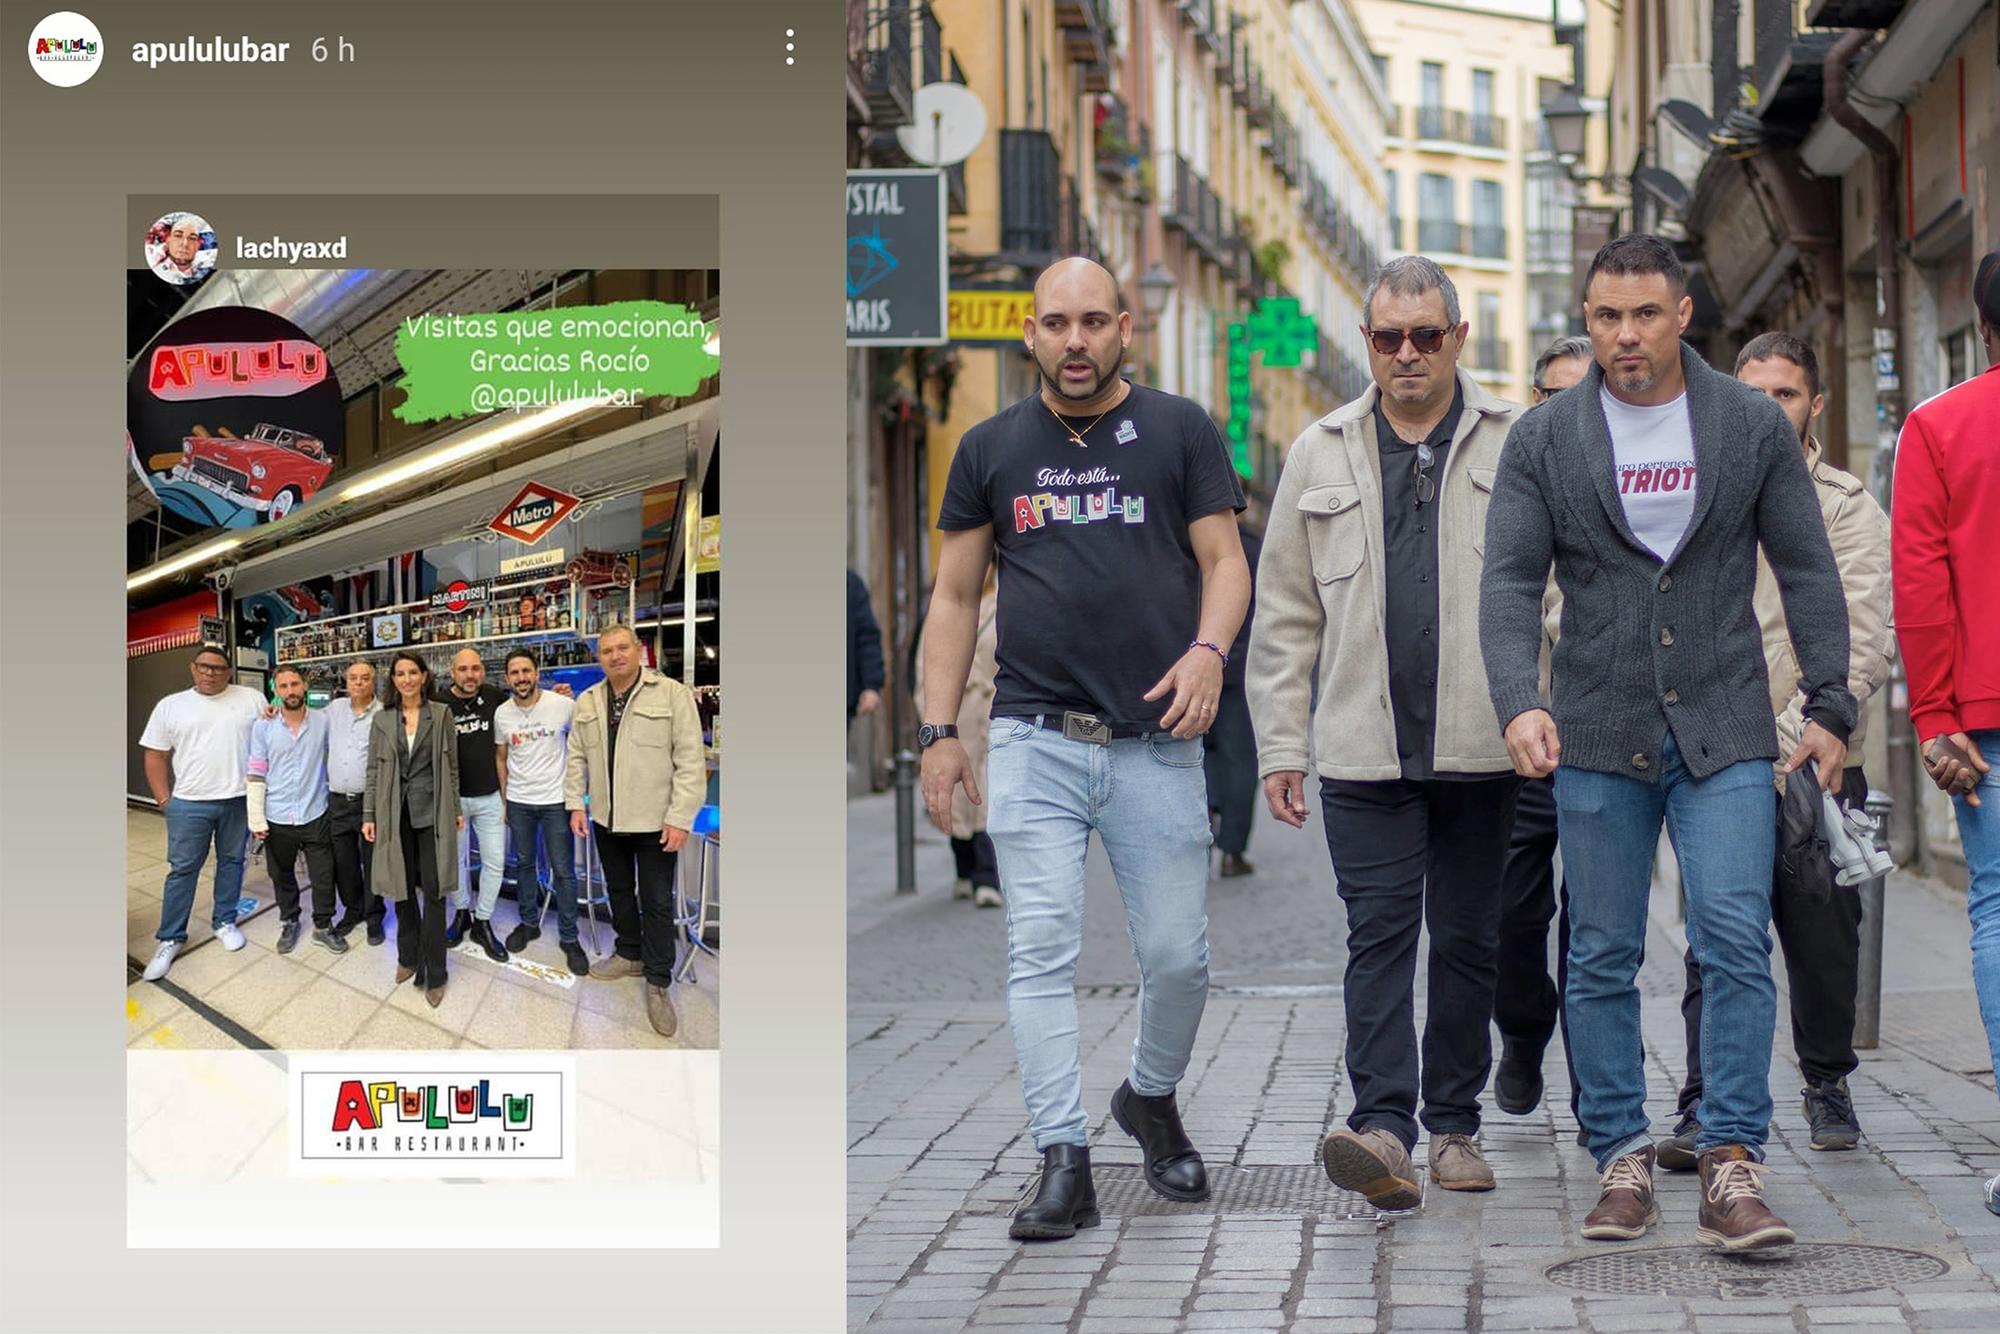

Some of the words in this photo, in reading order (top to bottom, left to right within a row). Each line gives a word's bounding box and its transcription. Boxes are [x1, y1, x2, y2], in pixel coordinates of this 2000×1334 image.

[149, 340, 324, 391] APULULU
[1037, 468, 1077, 487] Todo
[512, 505, 552, 526] Metro
[1013, 487, 1145, 533] APULULU
